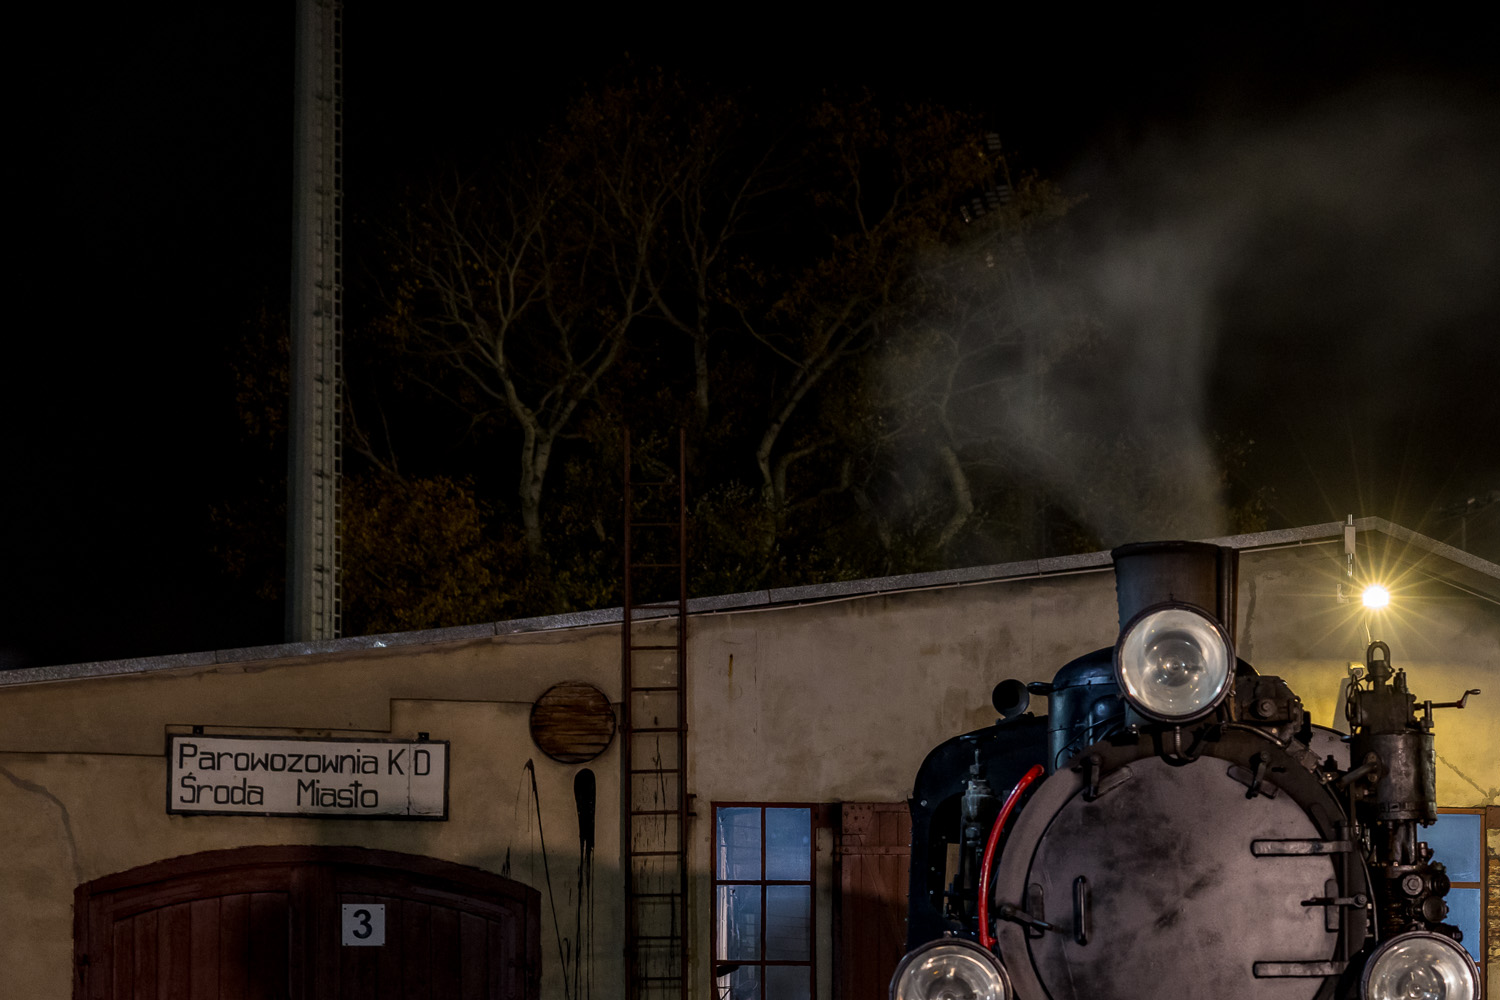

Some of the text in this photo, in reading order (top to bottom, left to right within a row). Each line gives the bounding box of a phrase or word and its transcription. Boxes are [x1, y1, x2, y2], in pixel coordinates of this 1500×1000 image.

[178, 743, 431, 777] Parowozownia K D
[179, 772, 379, 809] Środa Miasto
[353, 909, 373, 939] 3
